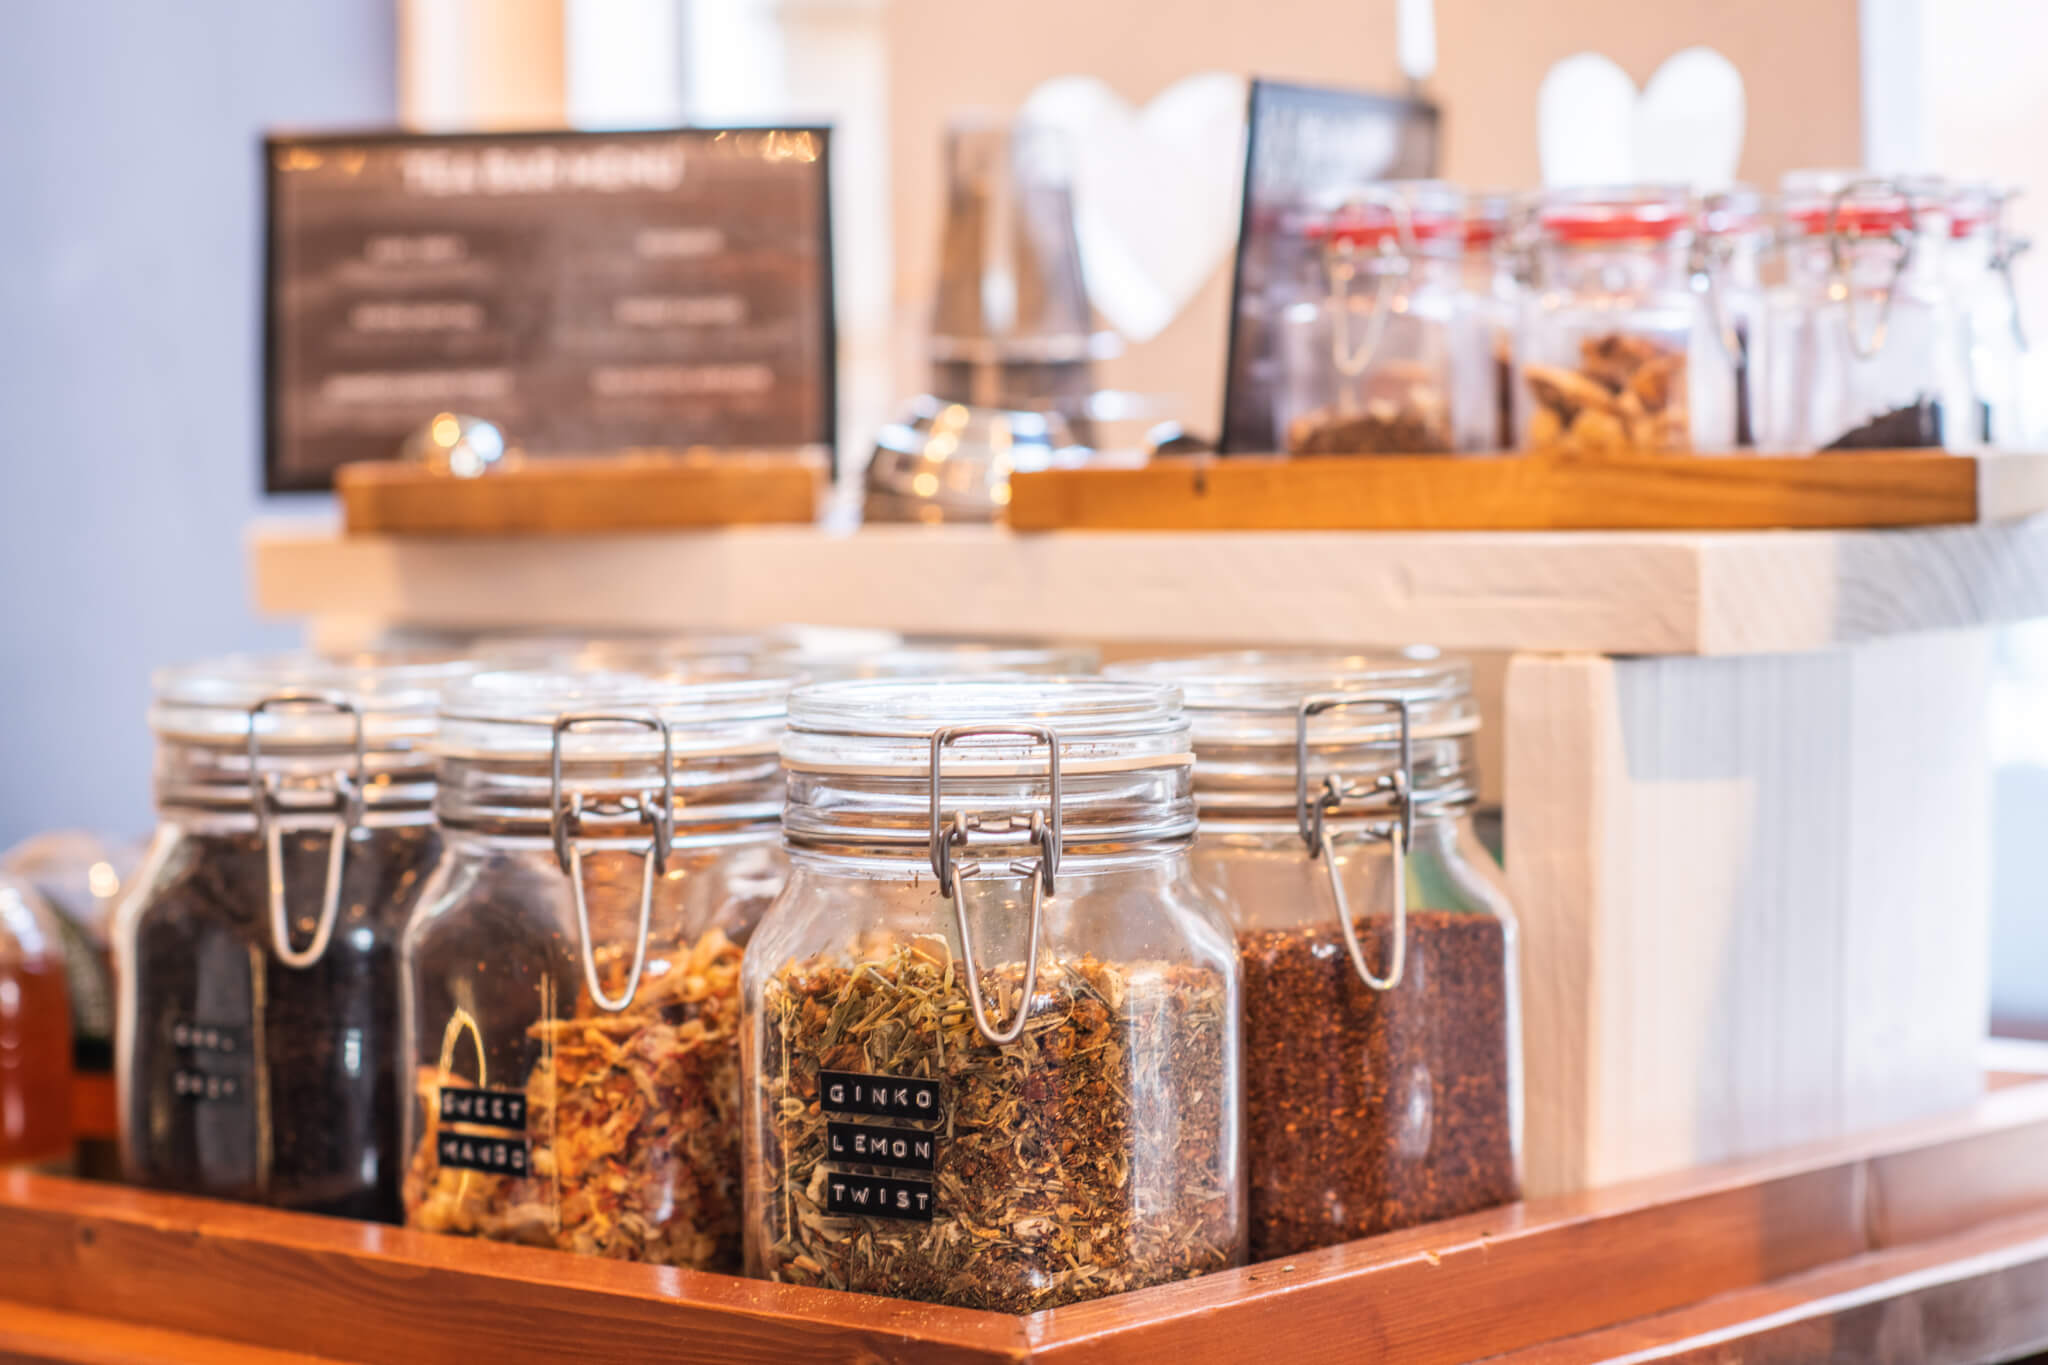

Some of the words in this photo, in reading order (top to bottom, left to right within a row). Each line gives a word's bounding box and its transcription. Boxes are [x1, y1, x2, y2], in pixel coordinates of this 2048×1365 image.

[442, 1091, 521, 1120] SWEET
[829, 1083, 932, 1108] GINKO
[441, 1140, 524, 1169] MANGO
[832, 1133, 931, 1160] LEMON
[832, 1183, 929, 1210] TWIST
